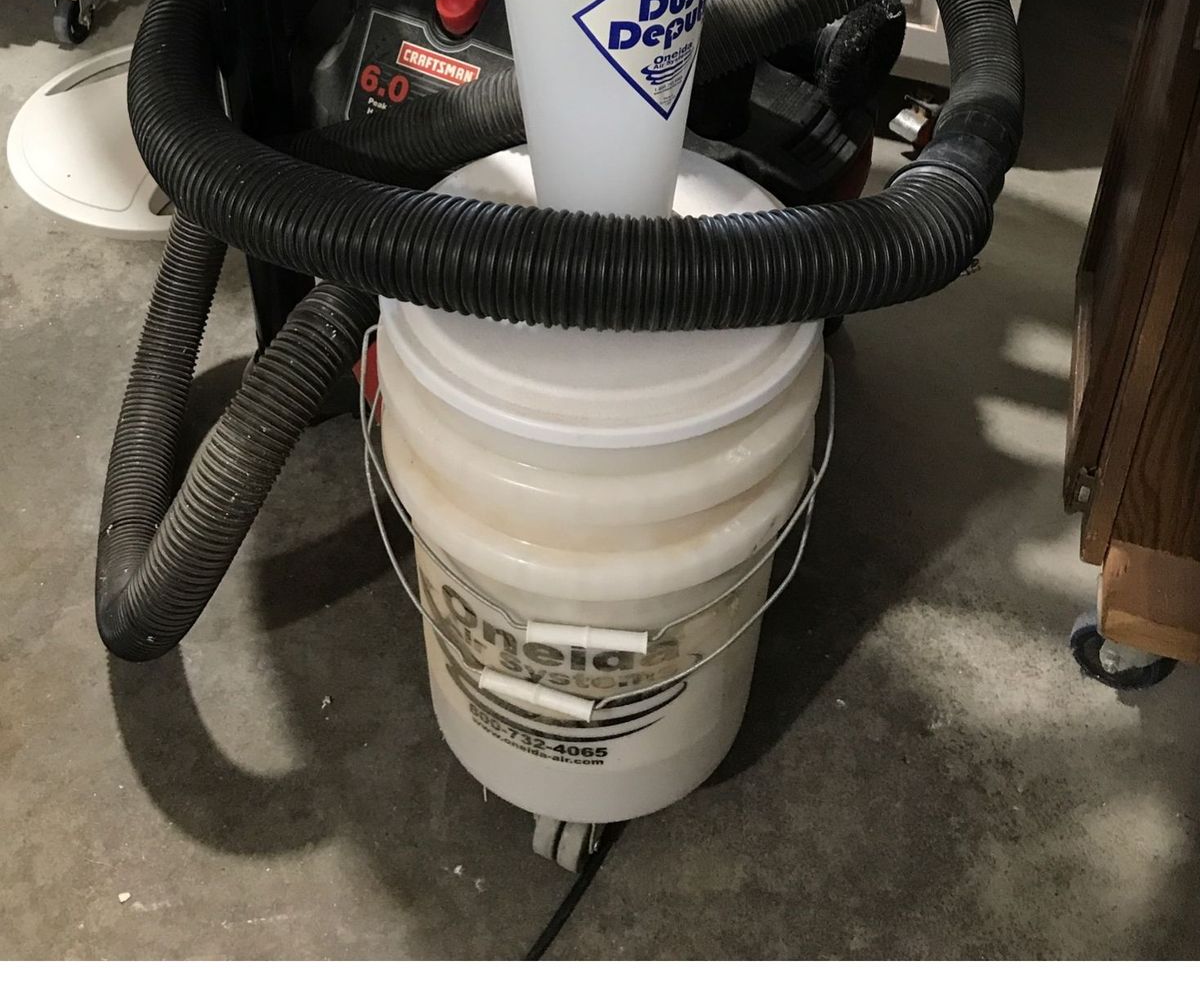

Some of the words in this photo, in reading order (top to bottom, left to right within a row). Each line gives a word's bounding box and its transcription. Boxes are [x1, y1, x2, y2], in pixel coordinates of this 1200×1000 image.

[402, 48, 475, 83] CRAFTSMAN
[653, 41, 693, 65] Oneida
[360, 64, 410, 103] 6.0
[368, 97, 388, 110] Peak
[469, 703, 608, 758] 800-732-4065
[471, 716, 604, 766] www.oneida-air.com
